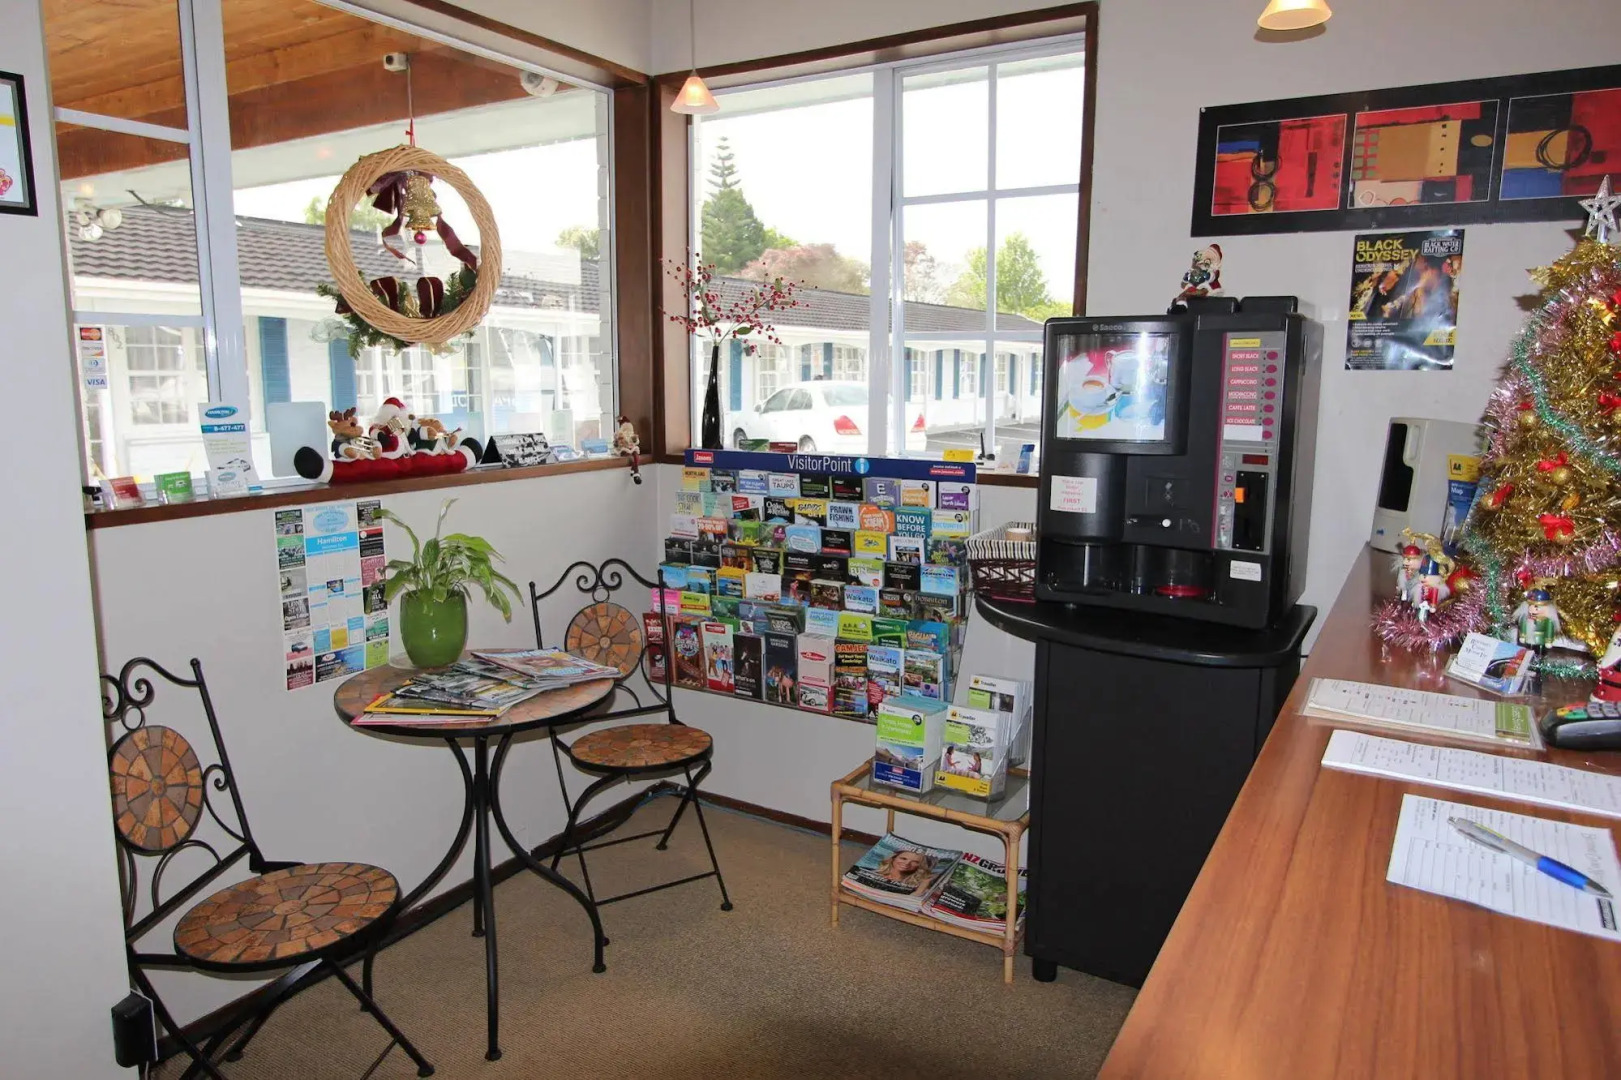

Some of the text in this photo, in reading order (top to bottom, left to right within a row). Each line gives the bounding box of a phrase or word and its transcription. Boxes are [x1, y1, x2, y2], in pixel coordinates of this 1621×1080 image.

[1357, 240, 1403, 251] BLACK
[1424, 246, 1448, 254] RAFTING
[1355, 249, 1419, 262] ODYSSEY
[1100, 323, 1122, 331] Saeco
[788, 455, 851, 473] VisitorPoint
[1451, 487, 1464, 495] Map
[830, 506, 853, 514] PRAWN
[829, 513, 854, 522] FISHING
[896, 515, 925, 524] KNOW
[897, 524, 925, 533] BEFORE
[316, 536, 347, 545] Hamilton
[897, 532, 912, 540] YOU
[846, 594, 873, 603] Waikato
[869, 655, 897, 665] Waikato
[958, 713, 976, 721] Traveller
[884, 833, 923, 853] Women's
